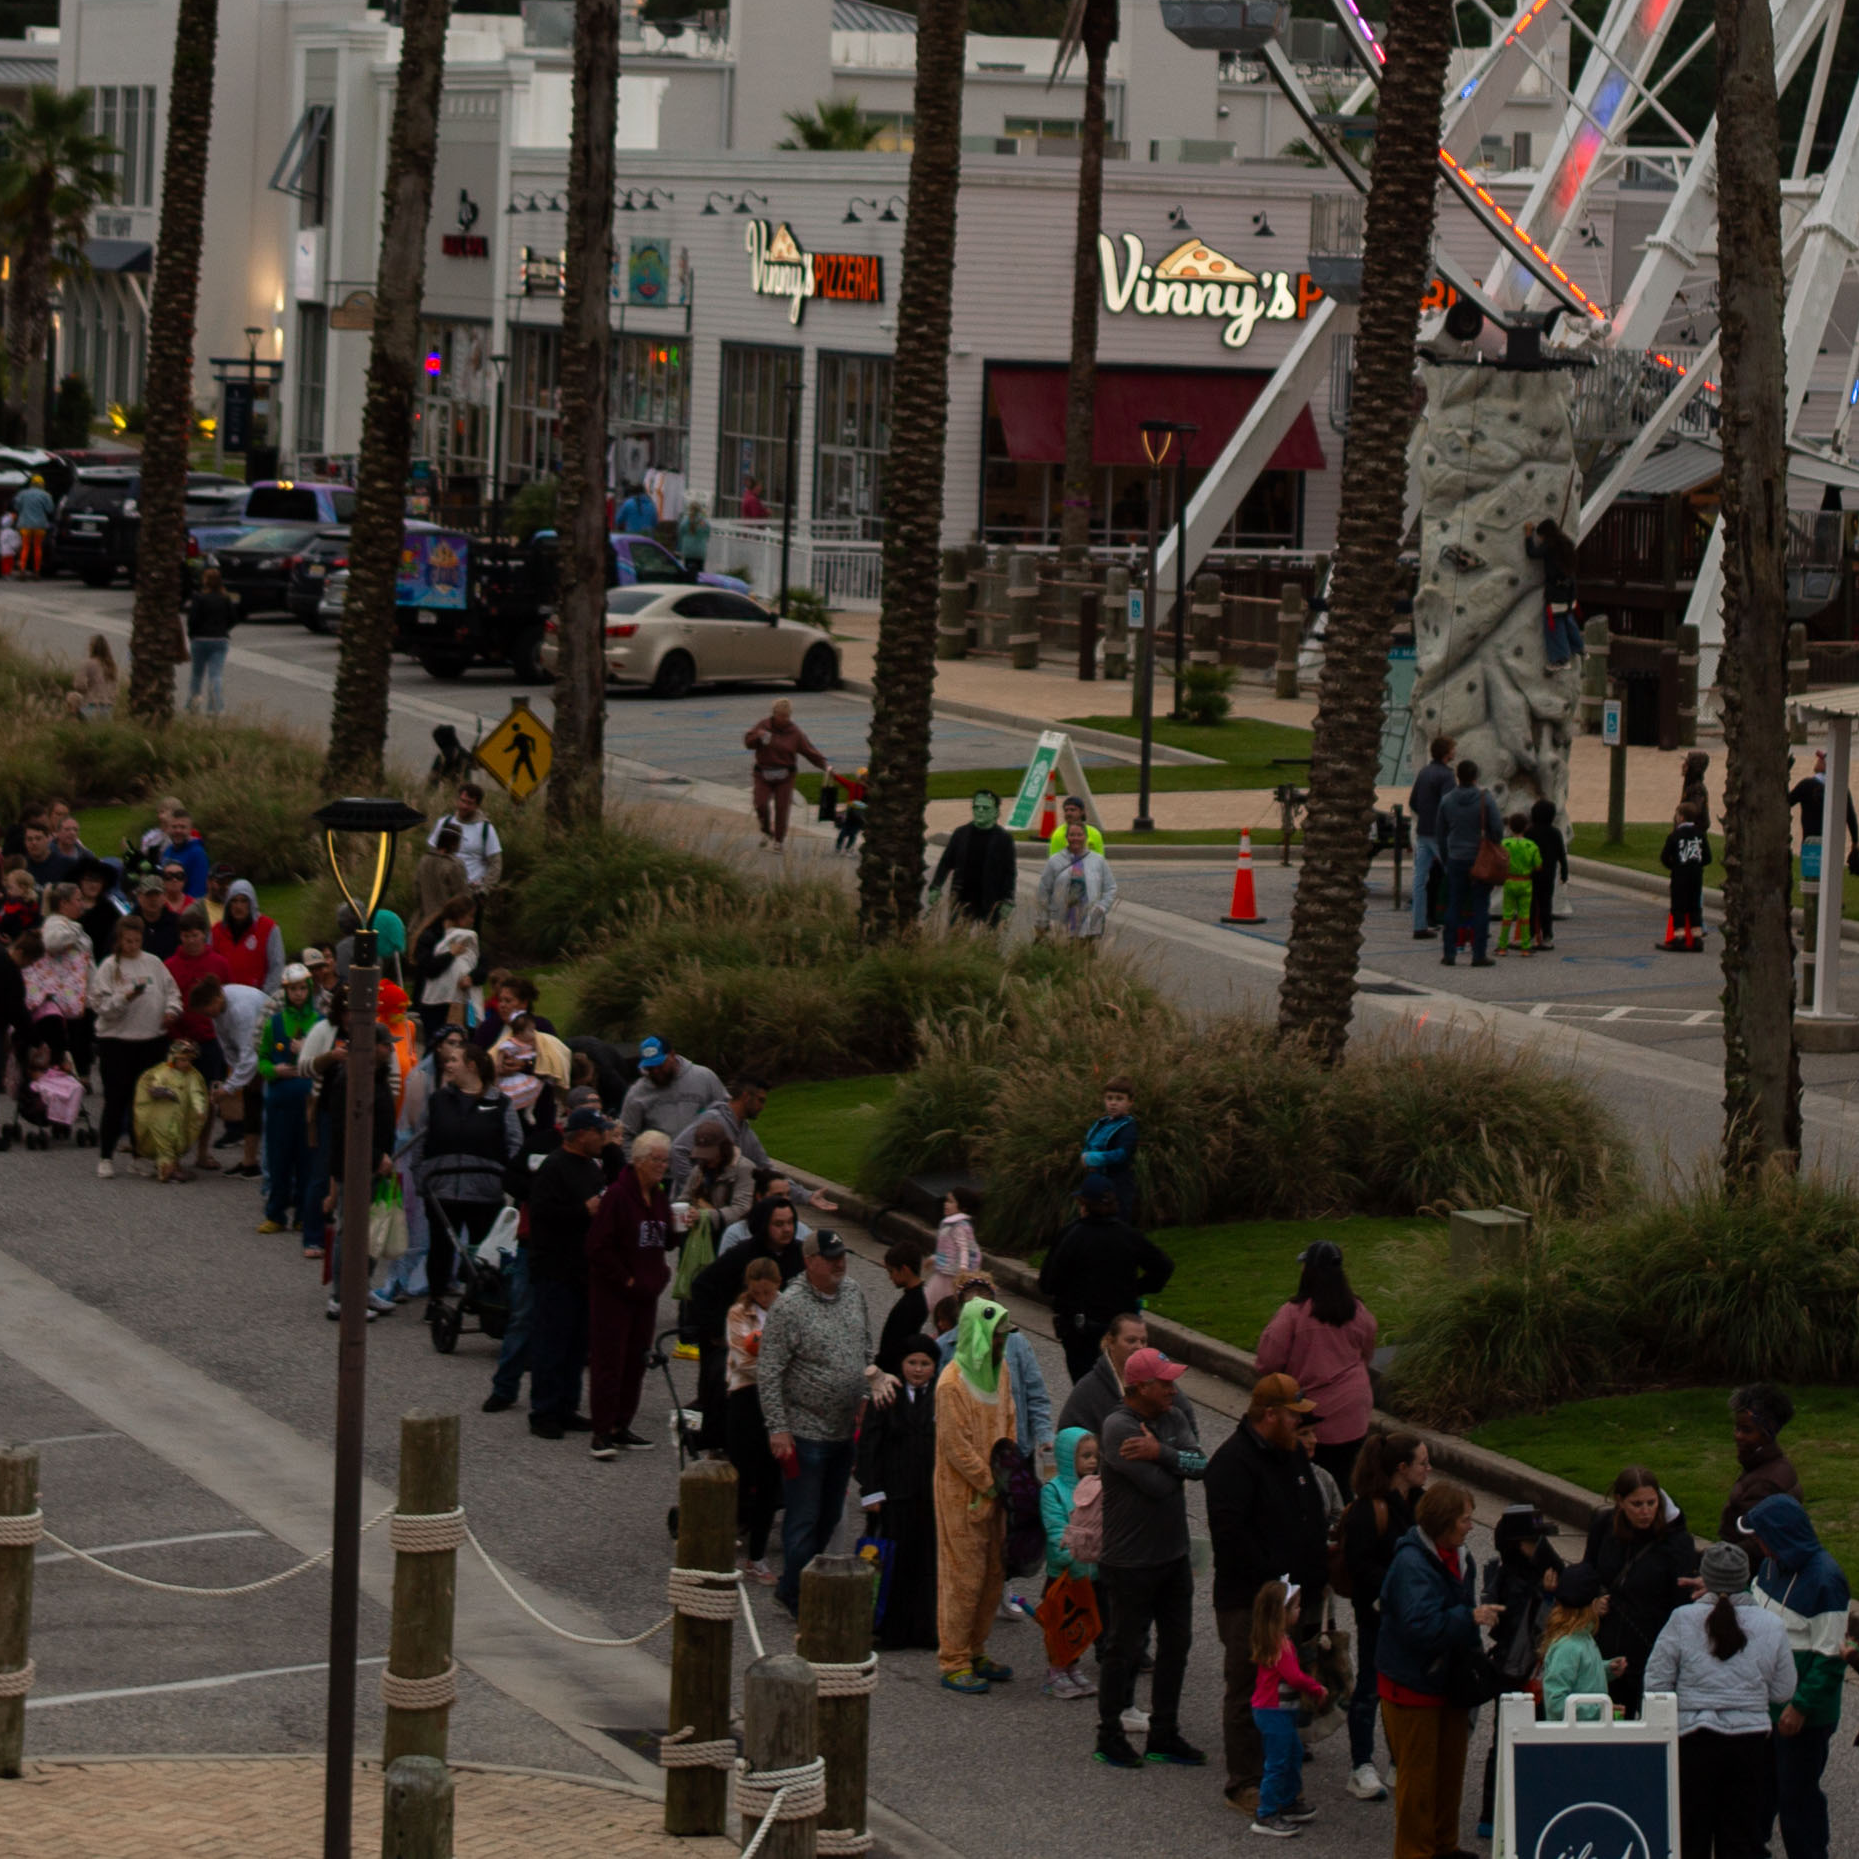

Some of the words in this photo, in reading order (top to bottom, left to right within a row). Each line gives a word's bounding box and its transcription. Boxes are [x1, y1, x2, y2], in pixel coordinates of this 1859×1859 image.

[745, 219, 815, 325] Vinny's
[814, 252, 882, 301] PIZZERIA
[1097, 232, 1297, 348] Vinny's
